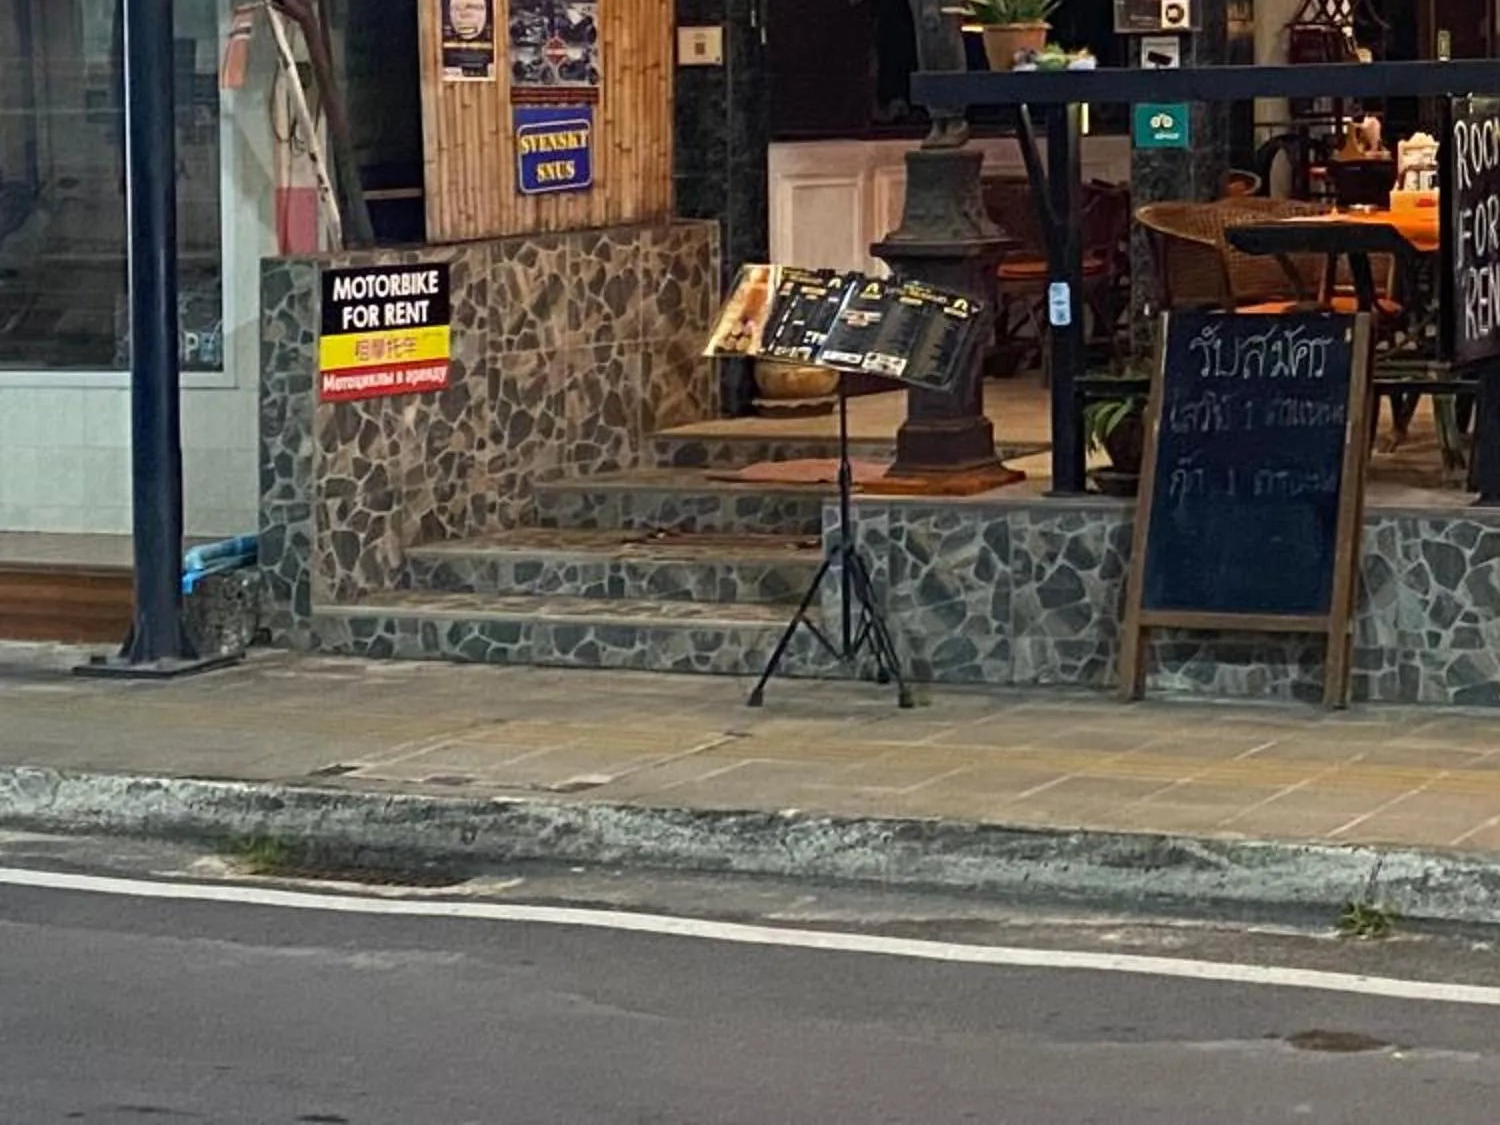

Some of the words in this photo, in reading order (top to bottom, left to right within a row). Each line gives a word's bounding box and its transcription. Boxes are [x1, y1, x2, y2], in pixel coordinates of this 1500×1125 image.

[1456, 194, 1500, 270] FOR
[332, 270, 439, 302] MOTORBIKE
[342, 304, 379, 330] FOR
[384, 299, 429, 326] RENT
